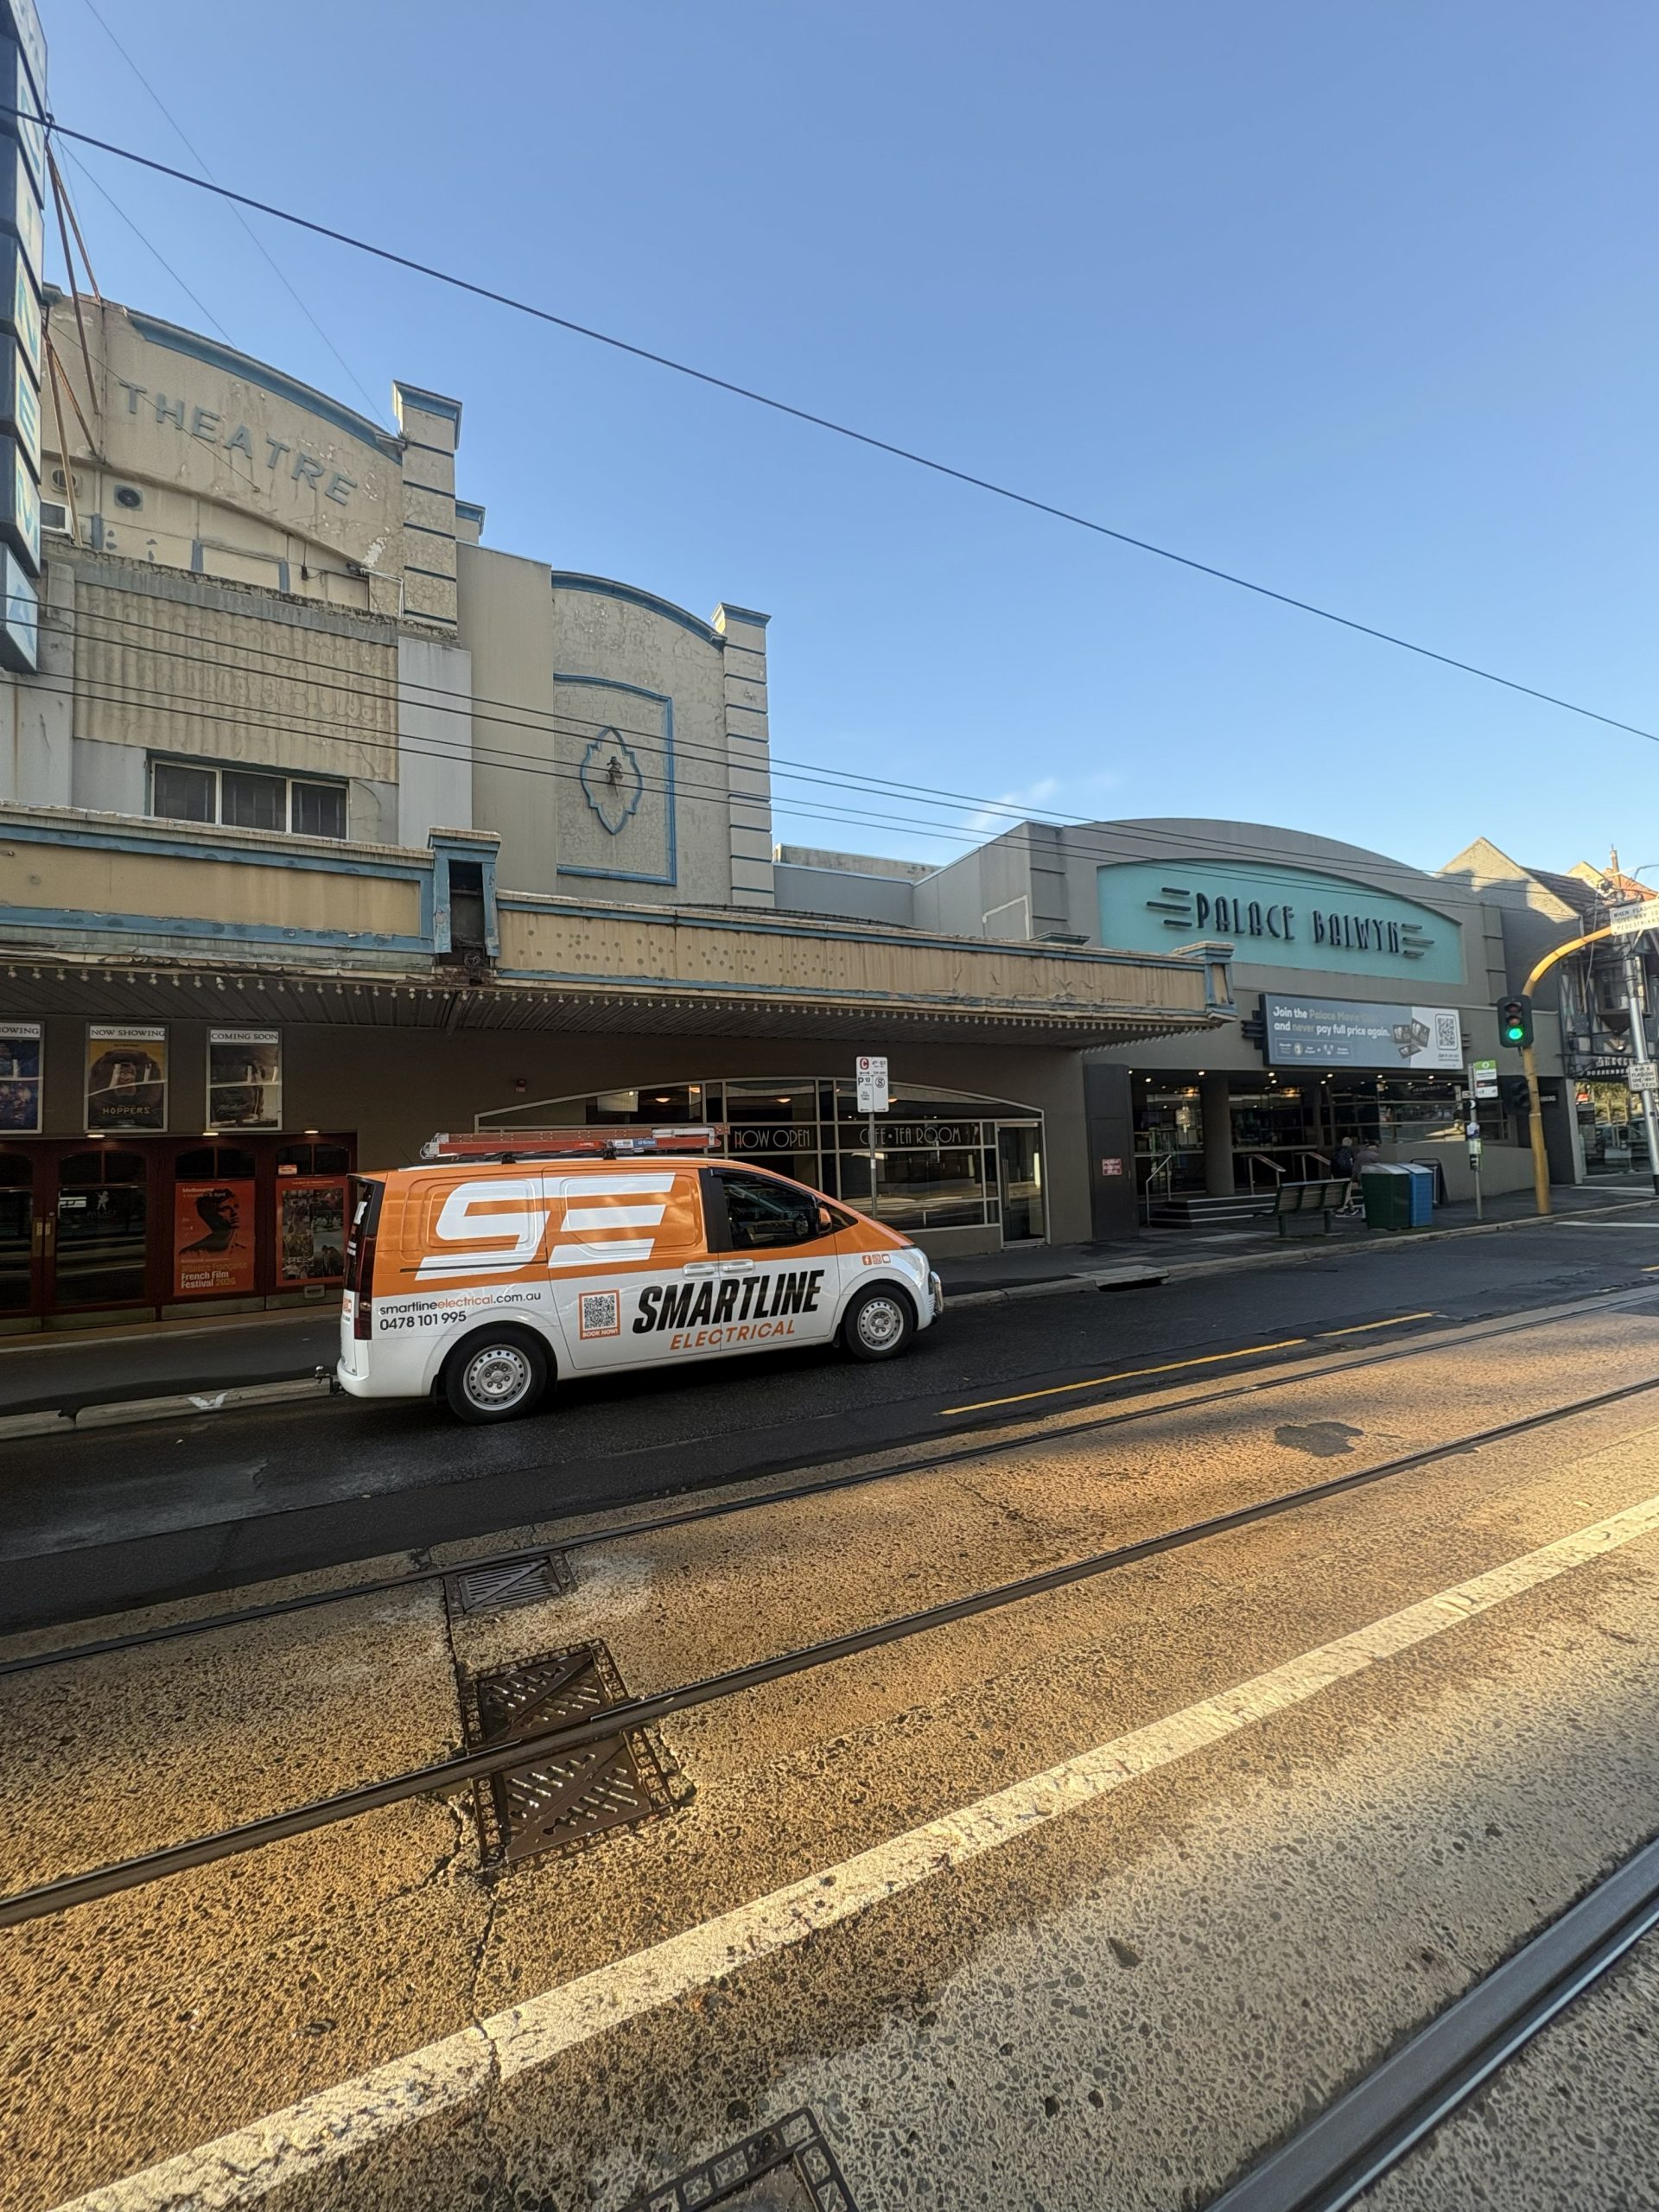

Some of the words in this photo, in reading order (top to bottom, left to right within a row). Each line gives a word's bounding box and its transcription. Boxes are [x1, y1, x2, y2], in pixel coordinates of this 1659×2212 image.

[119, 381, 358, 505] THEATRE
[1196, 892, 1295, 940] PALACE
[1313, 910, 1400, 953] BALWYN
[1273, 1006, 1293, 1018] Join
[1294, 1007, 1308, 1019] the
[1309, 1009, 1335, 1020] Palace
[0, 1027, 39, 1035] OWING
[1274, 1021, 1291, 1031] and
[1316, 1025, 1332, 1036] pay
[1332, 1023, 1346, 1034] full
[1347, 1026, 1365, 1037] price
[1367, 1027, 1390, 1039] again.
[858, 1077, 864, 1086] P
[734, 1129, 770, 1149] NOW
[772, 1128, 810, 1148] OPEN
[894, 1127, 912, 1145] TEA
[916, 1126, 962, 1144] ROOM
[181, 1271, 210, 1281] French
[212, 1270, 229, 1279] Film
[181, 1278, 214, 1289] Festival
[379, 1292, 542, 1315] smartlineelectrical.com.au
[632, 1269, 825, 1334] SMARTLINE
[379, 1316, 415, 1331] 0478
[418, 1313, 438, 1327] 101
[441, 1311, 467, 1324] 995
[670, 1319, 796, 1351] ELECTRICAL
